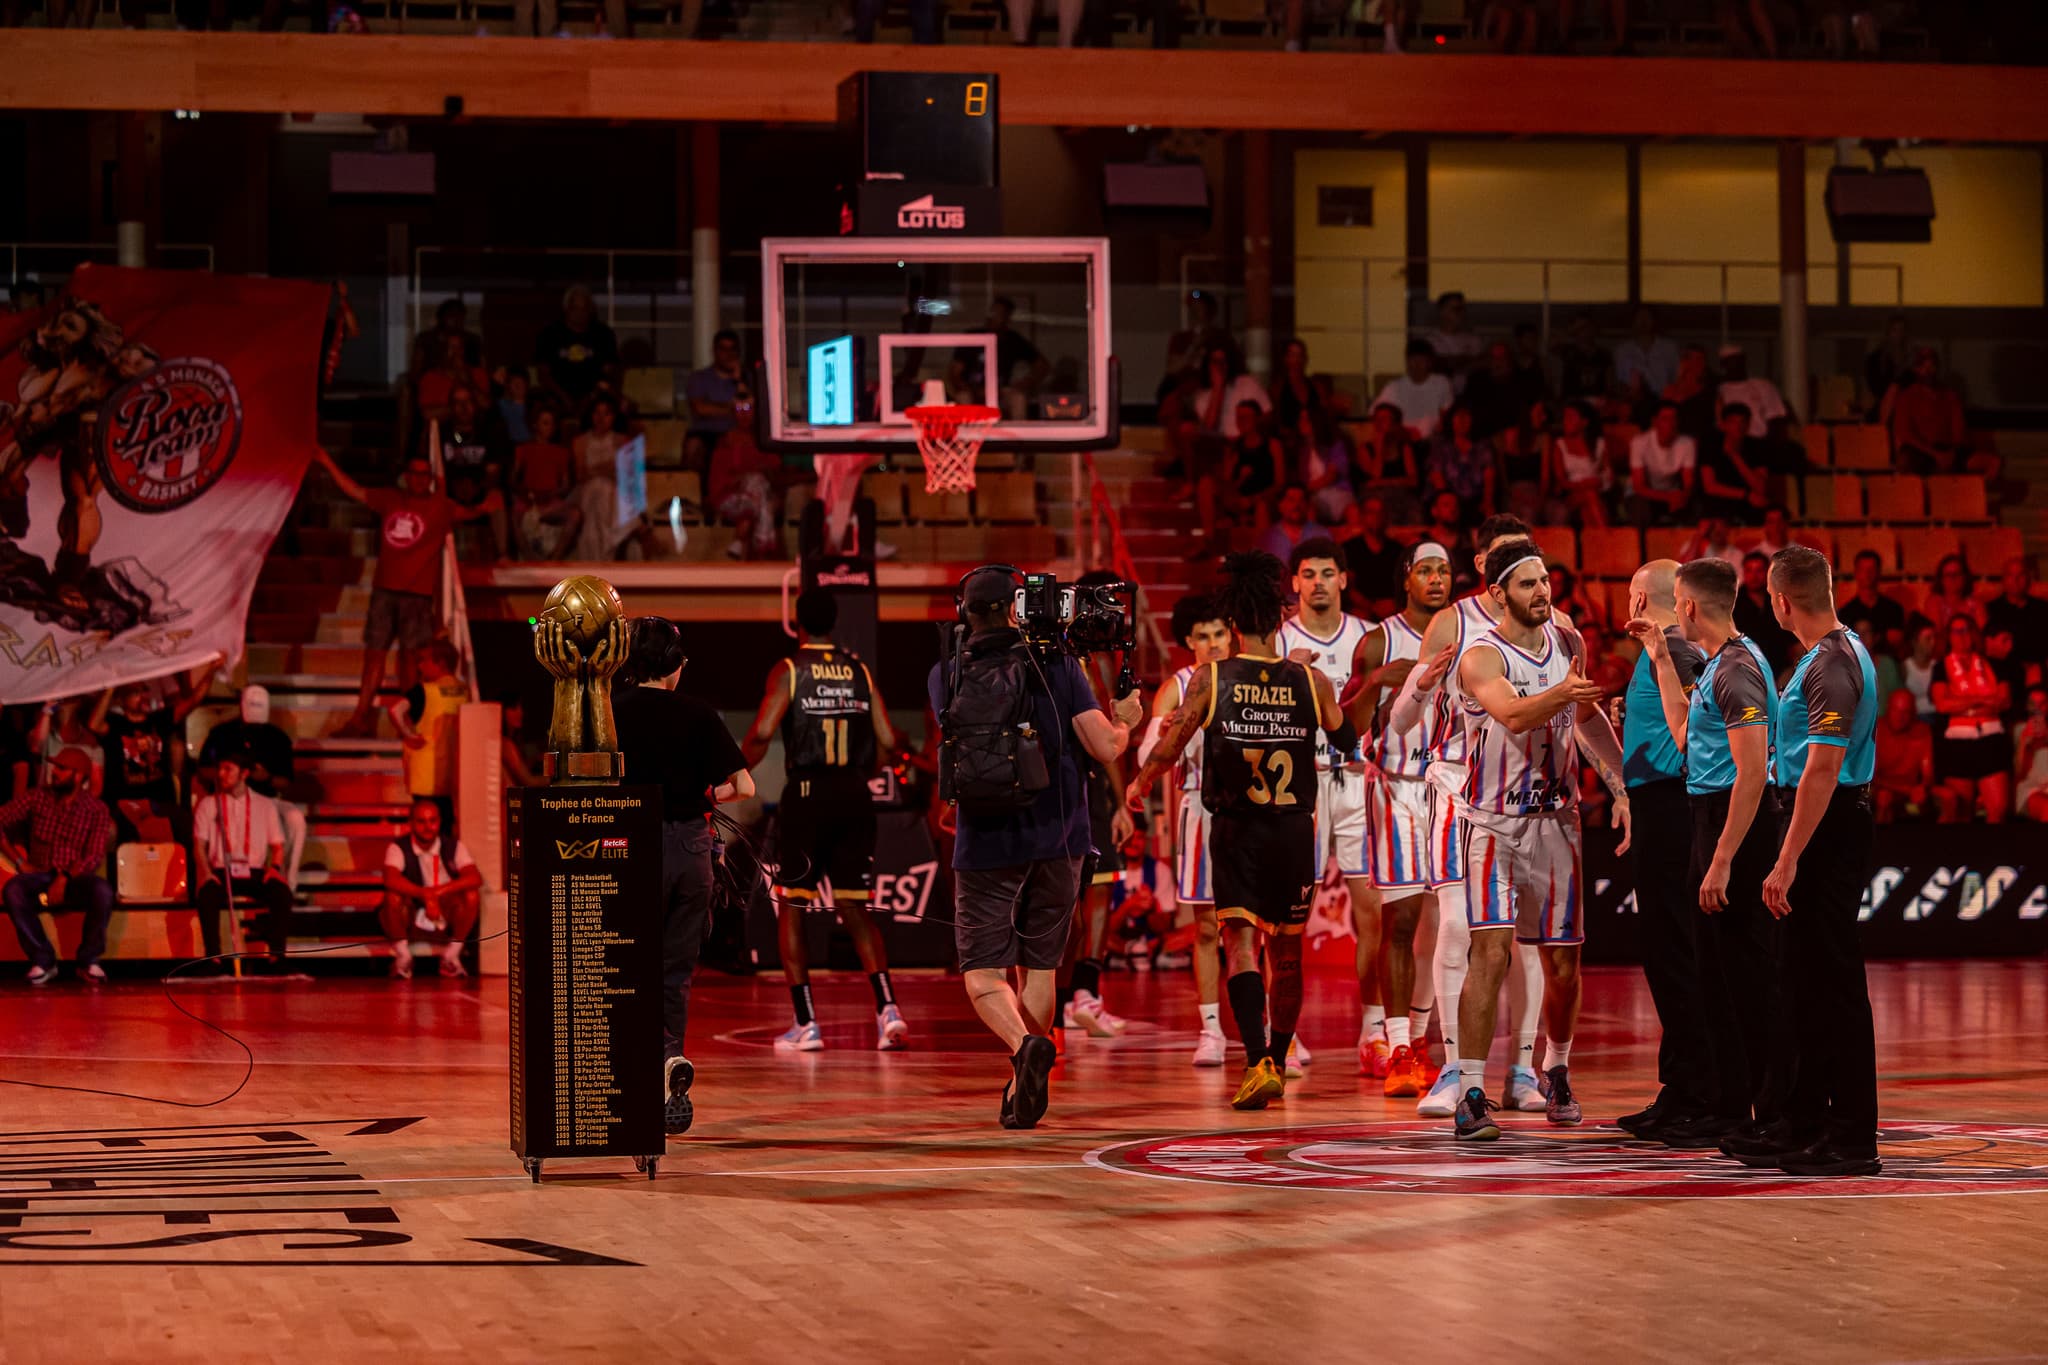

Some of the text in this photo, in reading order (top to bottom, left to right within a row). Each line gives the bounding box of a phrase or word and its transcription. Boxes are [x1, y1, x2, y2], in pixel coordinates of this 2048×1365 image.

[964, 81, 988, 117] 8
[898, 211, 966, 229] LOTUS
[114, 388, 229, 453] Roca
[121, 421, 222, 476] Team
[811, 663, 854, 681] DIALLO
[1233, 684, 1296, 706] STRAZEL
[822, 718, 848, 767] 11
[1542, 744, 1550, 768] 7
[1242, 748, 1298, 806] 32
[800, 780, 810, 798] 11
[581, 798, 592, 808] de
[595, 797, 641, 809] Champion
[568, 813, 614, 823] de France
